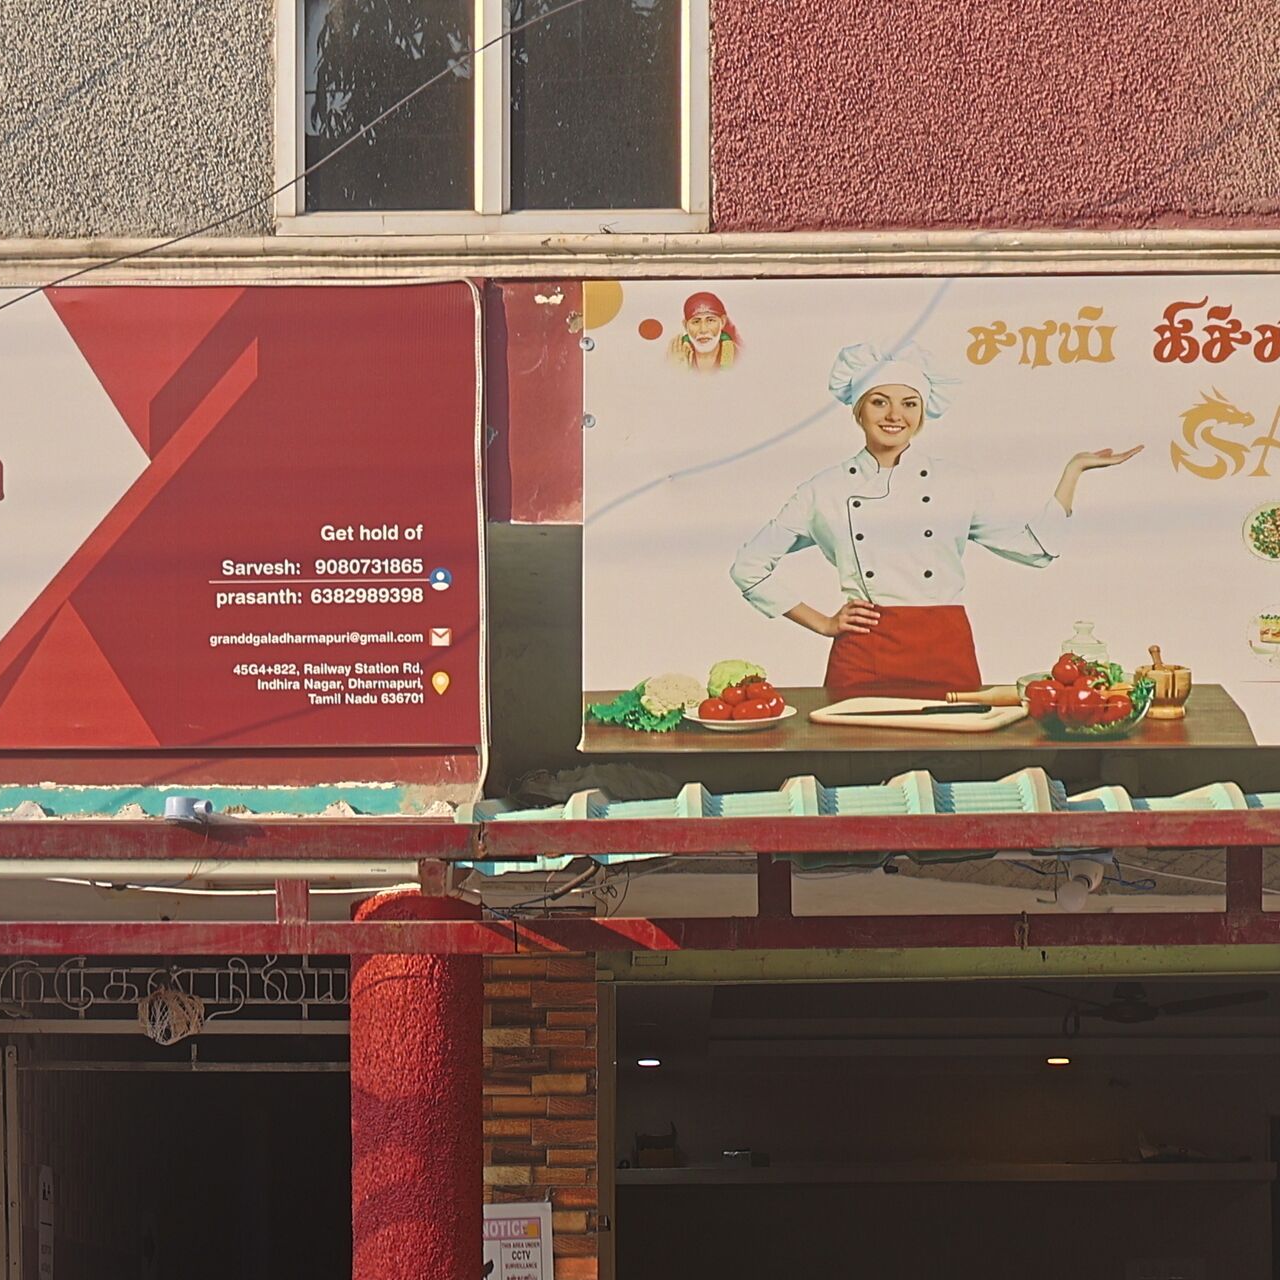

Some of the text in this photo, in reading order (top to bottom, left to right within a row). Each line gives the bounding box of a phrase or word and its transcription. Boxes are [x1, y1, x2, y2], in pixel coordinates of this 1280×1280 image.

[966, 306, 1118, 370] சாய்
[320, 523, 424, 541] Get hold of
[221, 558, 424, 576] Sarvesh: 9080731865
[216, 587, 424, 608] prasanth: 6382989398
[209, 631, 424, 647] granddgaladharmapuri@gmail.com
[232, 662, 424, 677] 45G4+822, Railway Station Rd,
[257, 677, 424, 692] Indhira Nagar, Dharmapuri,
[308, 692, 424, 705] Tamil Nadu 636701
[511, 1250, 531, 1261] CCTV
